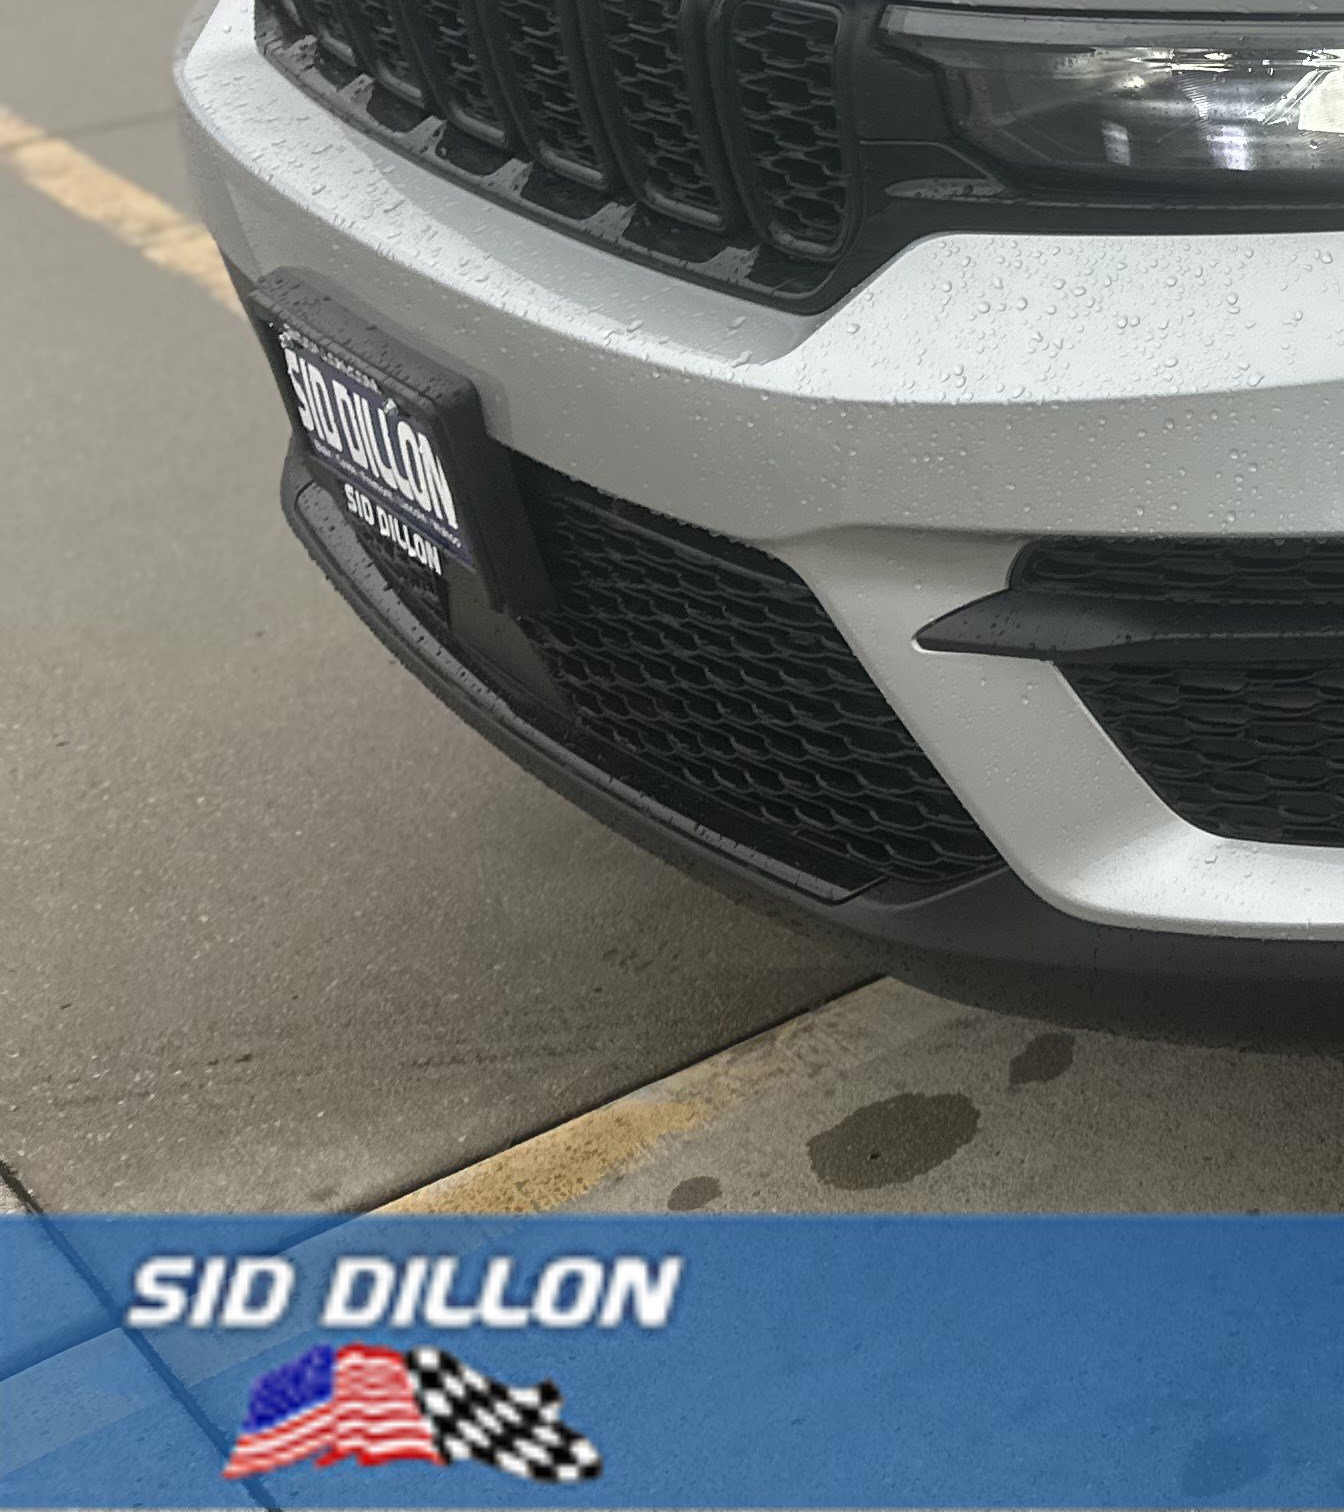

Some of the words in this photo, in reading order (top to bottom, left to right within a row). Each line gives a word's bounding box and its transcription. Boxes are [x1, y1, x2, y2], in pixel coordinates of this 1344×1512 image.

[285, 348, 343, 452] SID
[332, 379, 458, 530] DILLON
[344, 483, 375, 526] SID
[376, 505, 442, 576] DILLON
